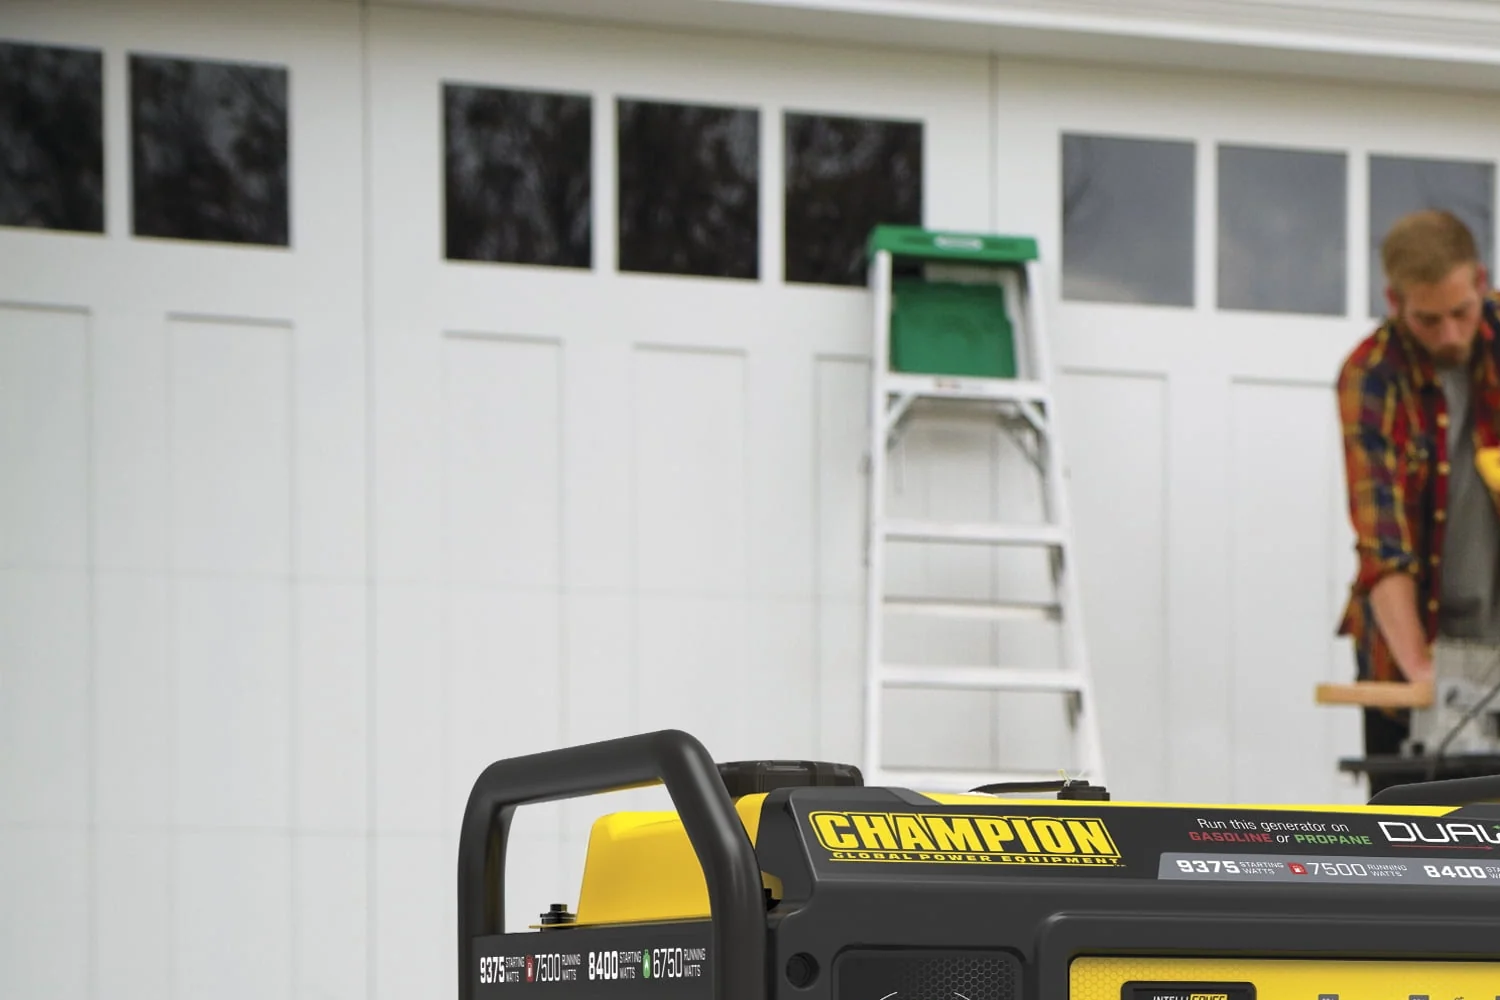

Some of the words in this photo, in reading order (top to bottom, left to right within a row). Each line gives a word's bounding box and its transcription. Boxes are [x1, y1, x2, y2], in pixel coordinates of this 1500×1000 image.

[1197, 818, 1226, 830] Run
[1229, 818, 1256, 831] this
[1261, 820, 1326, 834] generator
[1332, 823, 1350, 833] on
[814, 811, 1119, 857] CHAMPION
[1188, 831, 1273, 843] GASOLINE
[1276, 834, 1291, 844] or
[1294, 833, 1373, 846] PROPANE
[832, 851, 914, 861] GLOBAL
[919, 853, 993, 863] POWER
[1001, 855, 1121, 865] EQUIPMENT
[1239, 861, 1285, 869] STARTING
[1175, 859, 1240, 874] 9375
[1306, 862, 1368, 877] 7500
[1423, 864, 1487, 879] 8400
[1241, 867, 1275, 875] WATTS
[1367, 864, 1408, 872] RUNNING
[480, 956, 505, 984] 9375
[535, 953, 561, 982] 7500
[588, 951, 619, 981] 8400
[653, 947, 683, 979] 6750
